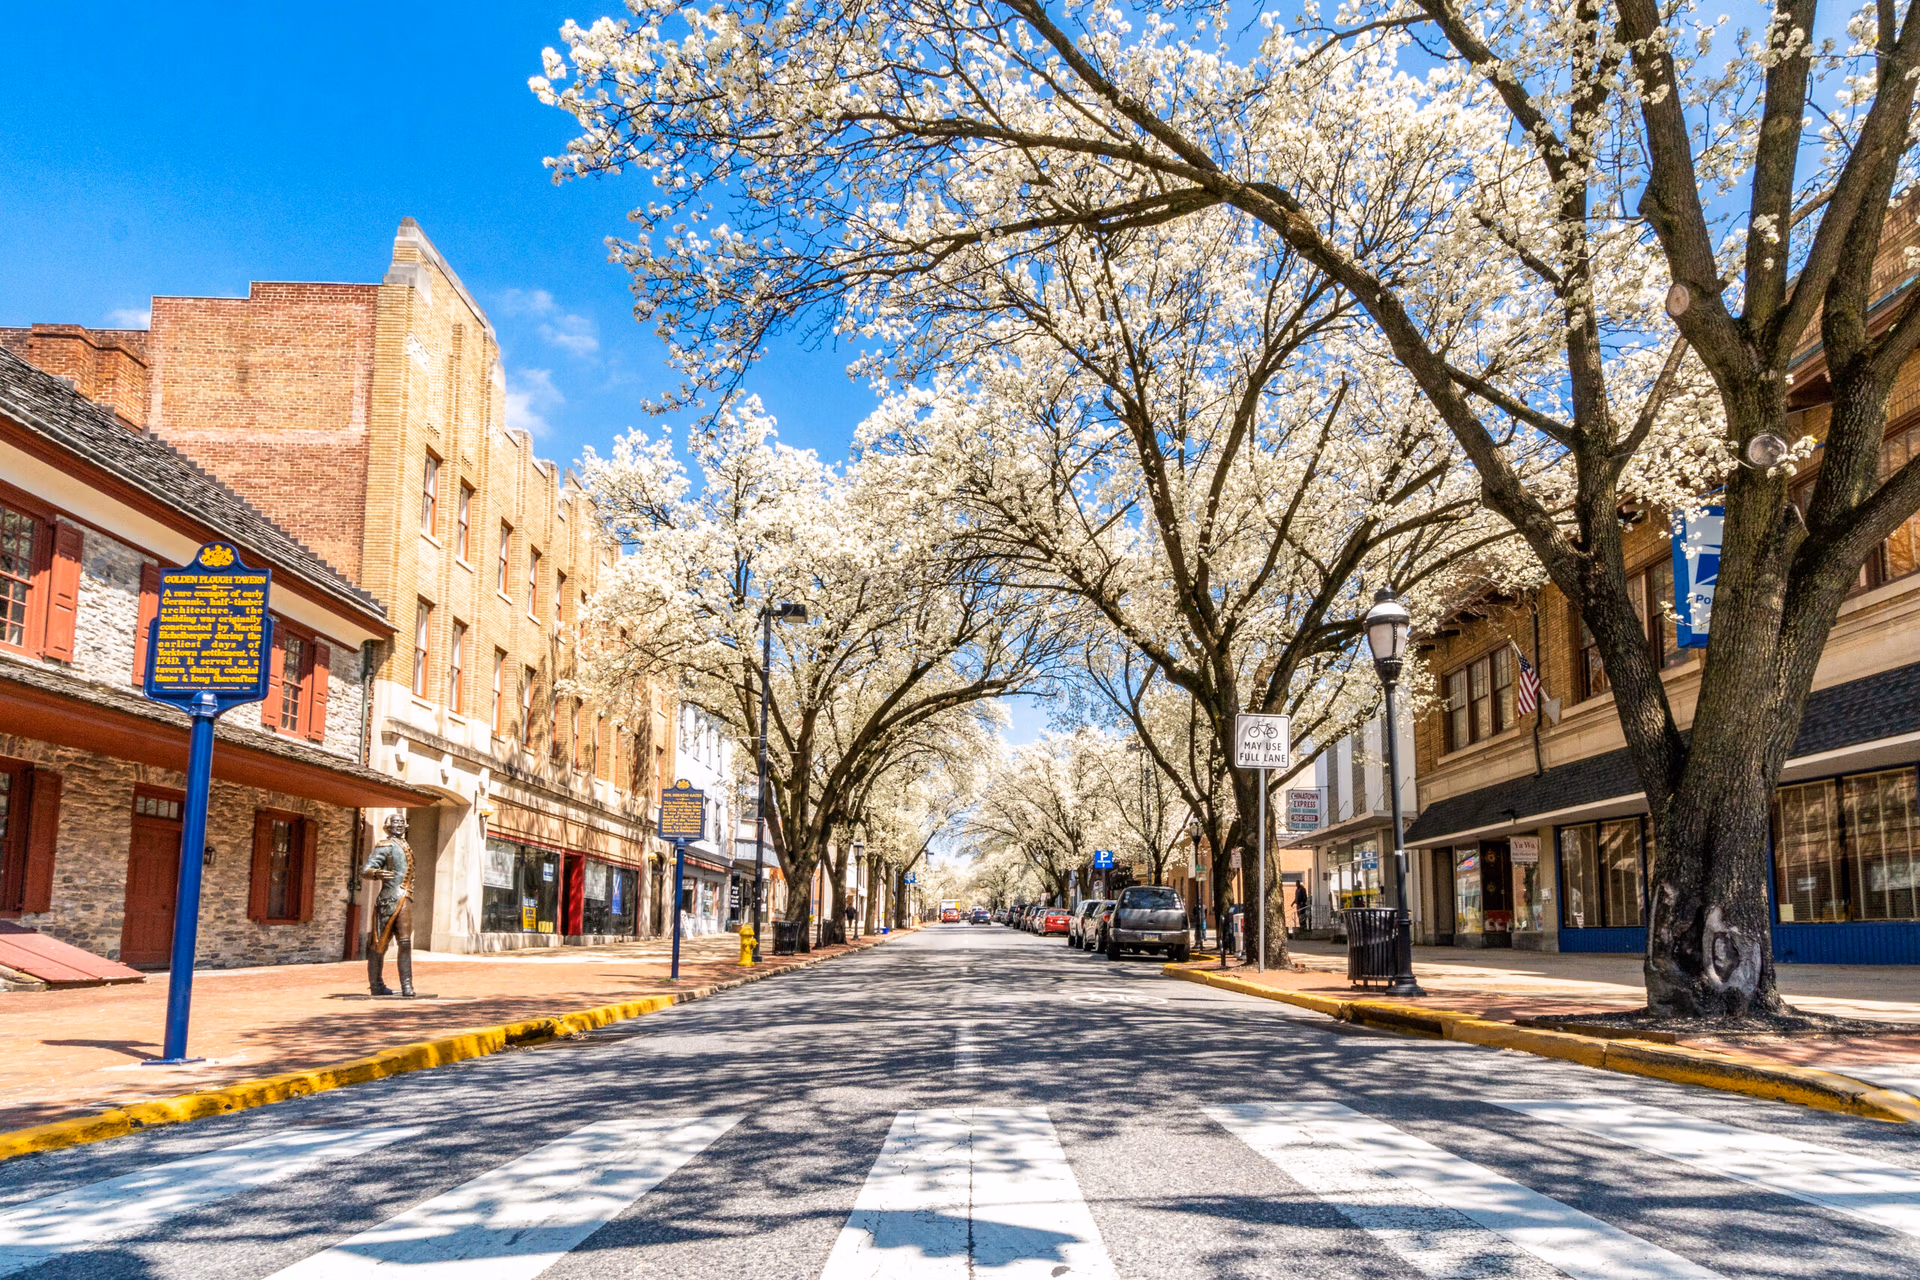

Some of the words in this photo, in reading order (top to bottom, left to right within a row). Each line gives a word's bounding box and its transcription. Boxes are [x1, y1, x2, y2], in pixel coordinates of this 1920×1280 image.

[194, 590, 229, 599] example
[242, 590, 264, 599] early
[1696, 594, 1712, 604] Po
[161, 615, 196, 624] building
[218, 615, 262, 625] originally
[217, 624, 229, 633] by
[159, 632, 212, 641] Eichelberger
[214, 632, 243, 641] during
[211, 641, 236, 650] days
[189, 666, 220, 675] during
[190, 675, 210, 684] long
[1244, 742, 1262, 750] MAY
[1265, 742, 1282, 750] USE
[1239, 753, 1260, 762] FULL
[1264, 754, 1286, 762] LANE
[1101, 851, 1108, 860] P
